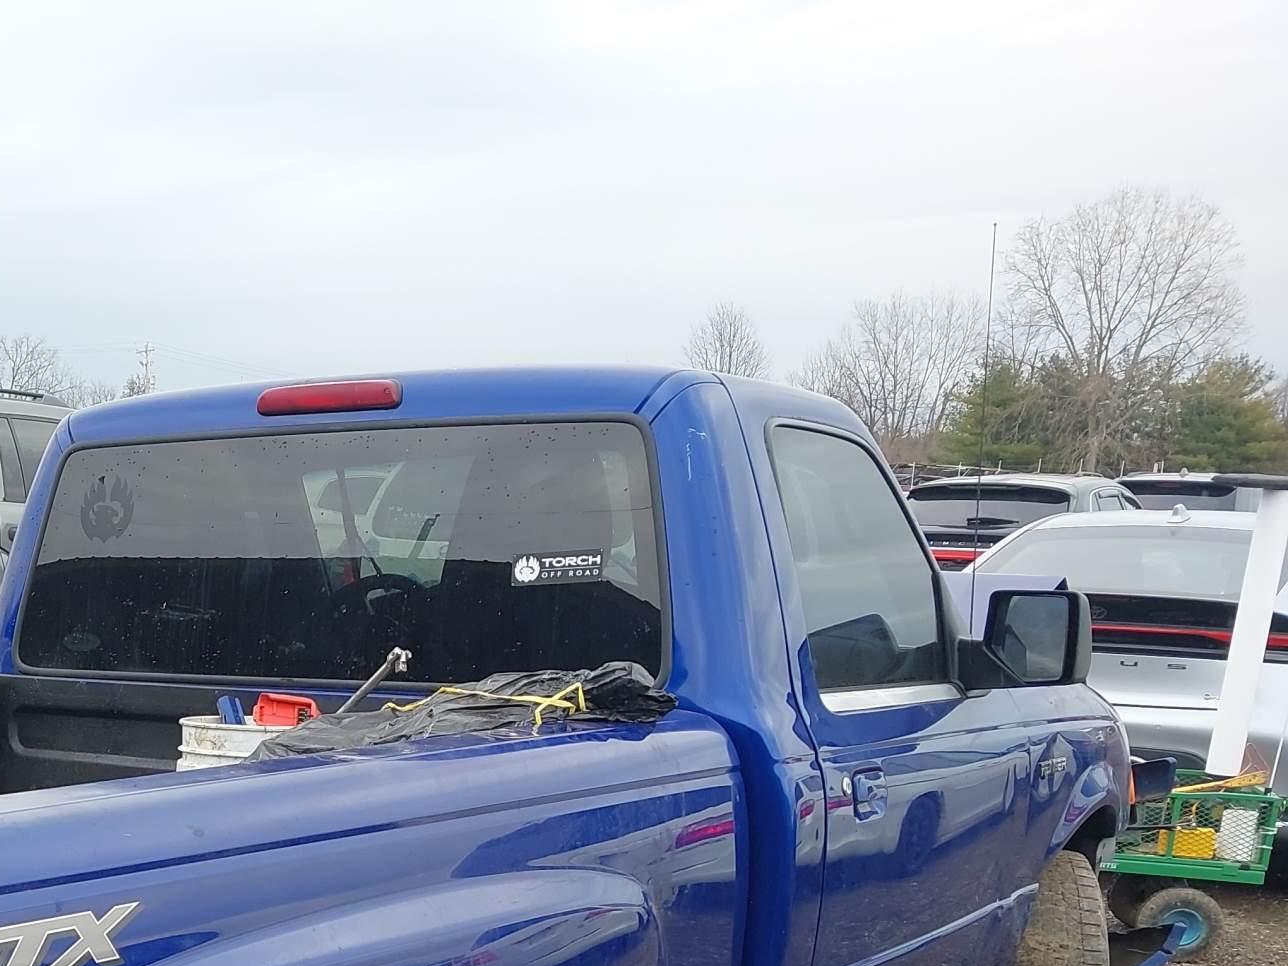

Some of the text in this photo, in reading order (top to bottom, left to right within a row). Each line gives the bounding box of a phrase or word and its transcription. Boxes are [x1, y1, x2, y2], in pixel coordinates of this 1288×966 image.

[541, 554, 601, 568] TORCH
[541, 568, 600, 578] OFF ROAD
